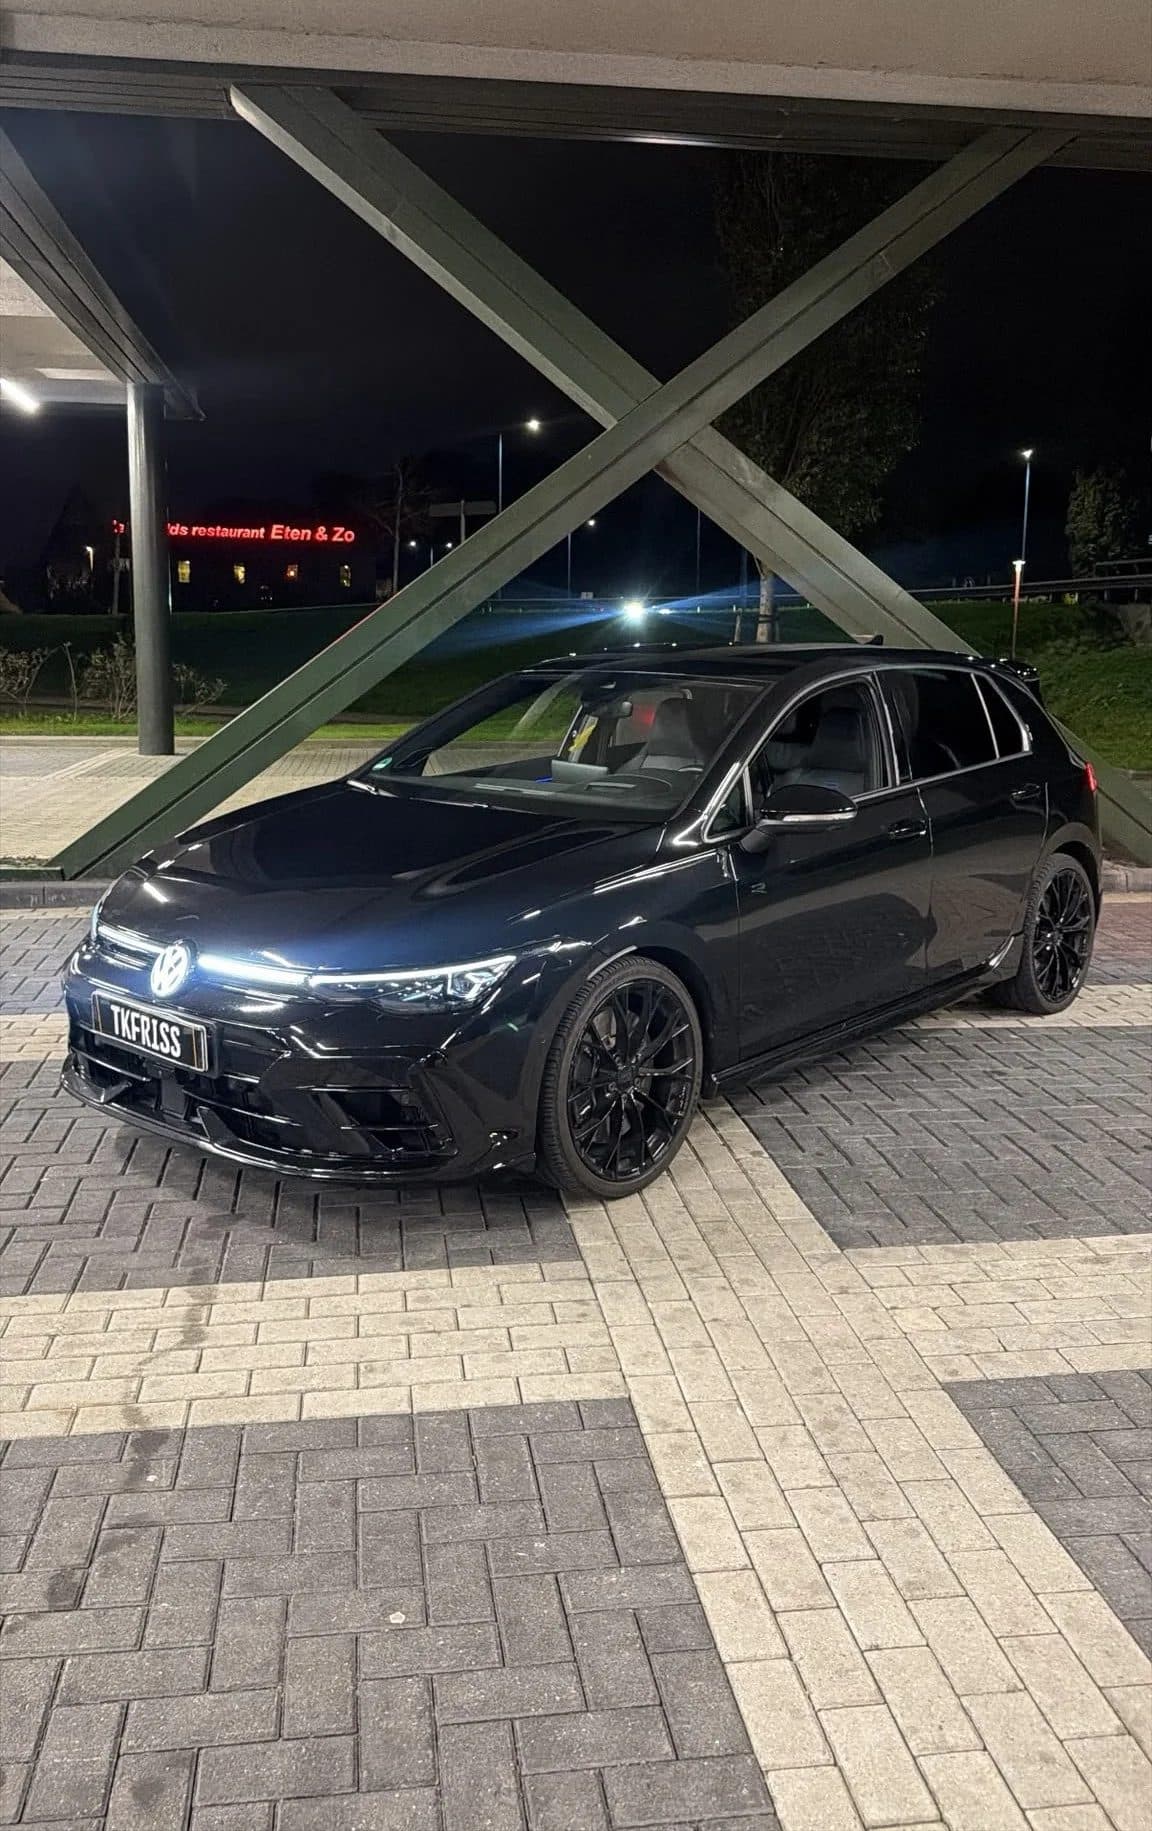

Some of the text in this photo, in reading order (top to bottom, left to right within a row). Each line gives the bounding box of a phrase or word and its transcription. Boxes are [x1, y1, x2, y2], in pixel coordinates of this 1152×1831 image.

[191, 525, 266, 539] restaurant
[271, 524, 312, 541] Eten
[315, 526, 328, 541] &
[331, 527, 355, 542] Zo
[110, 1004, 182, 1058] TKFRISS
